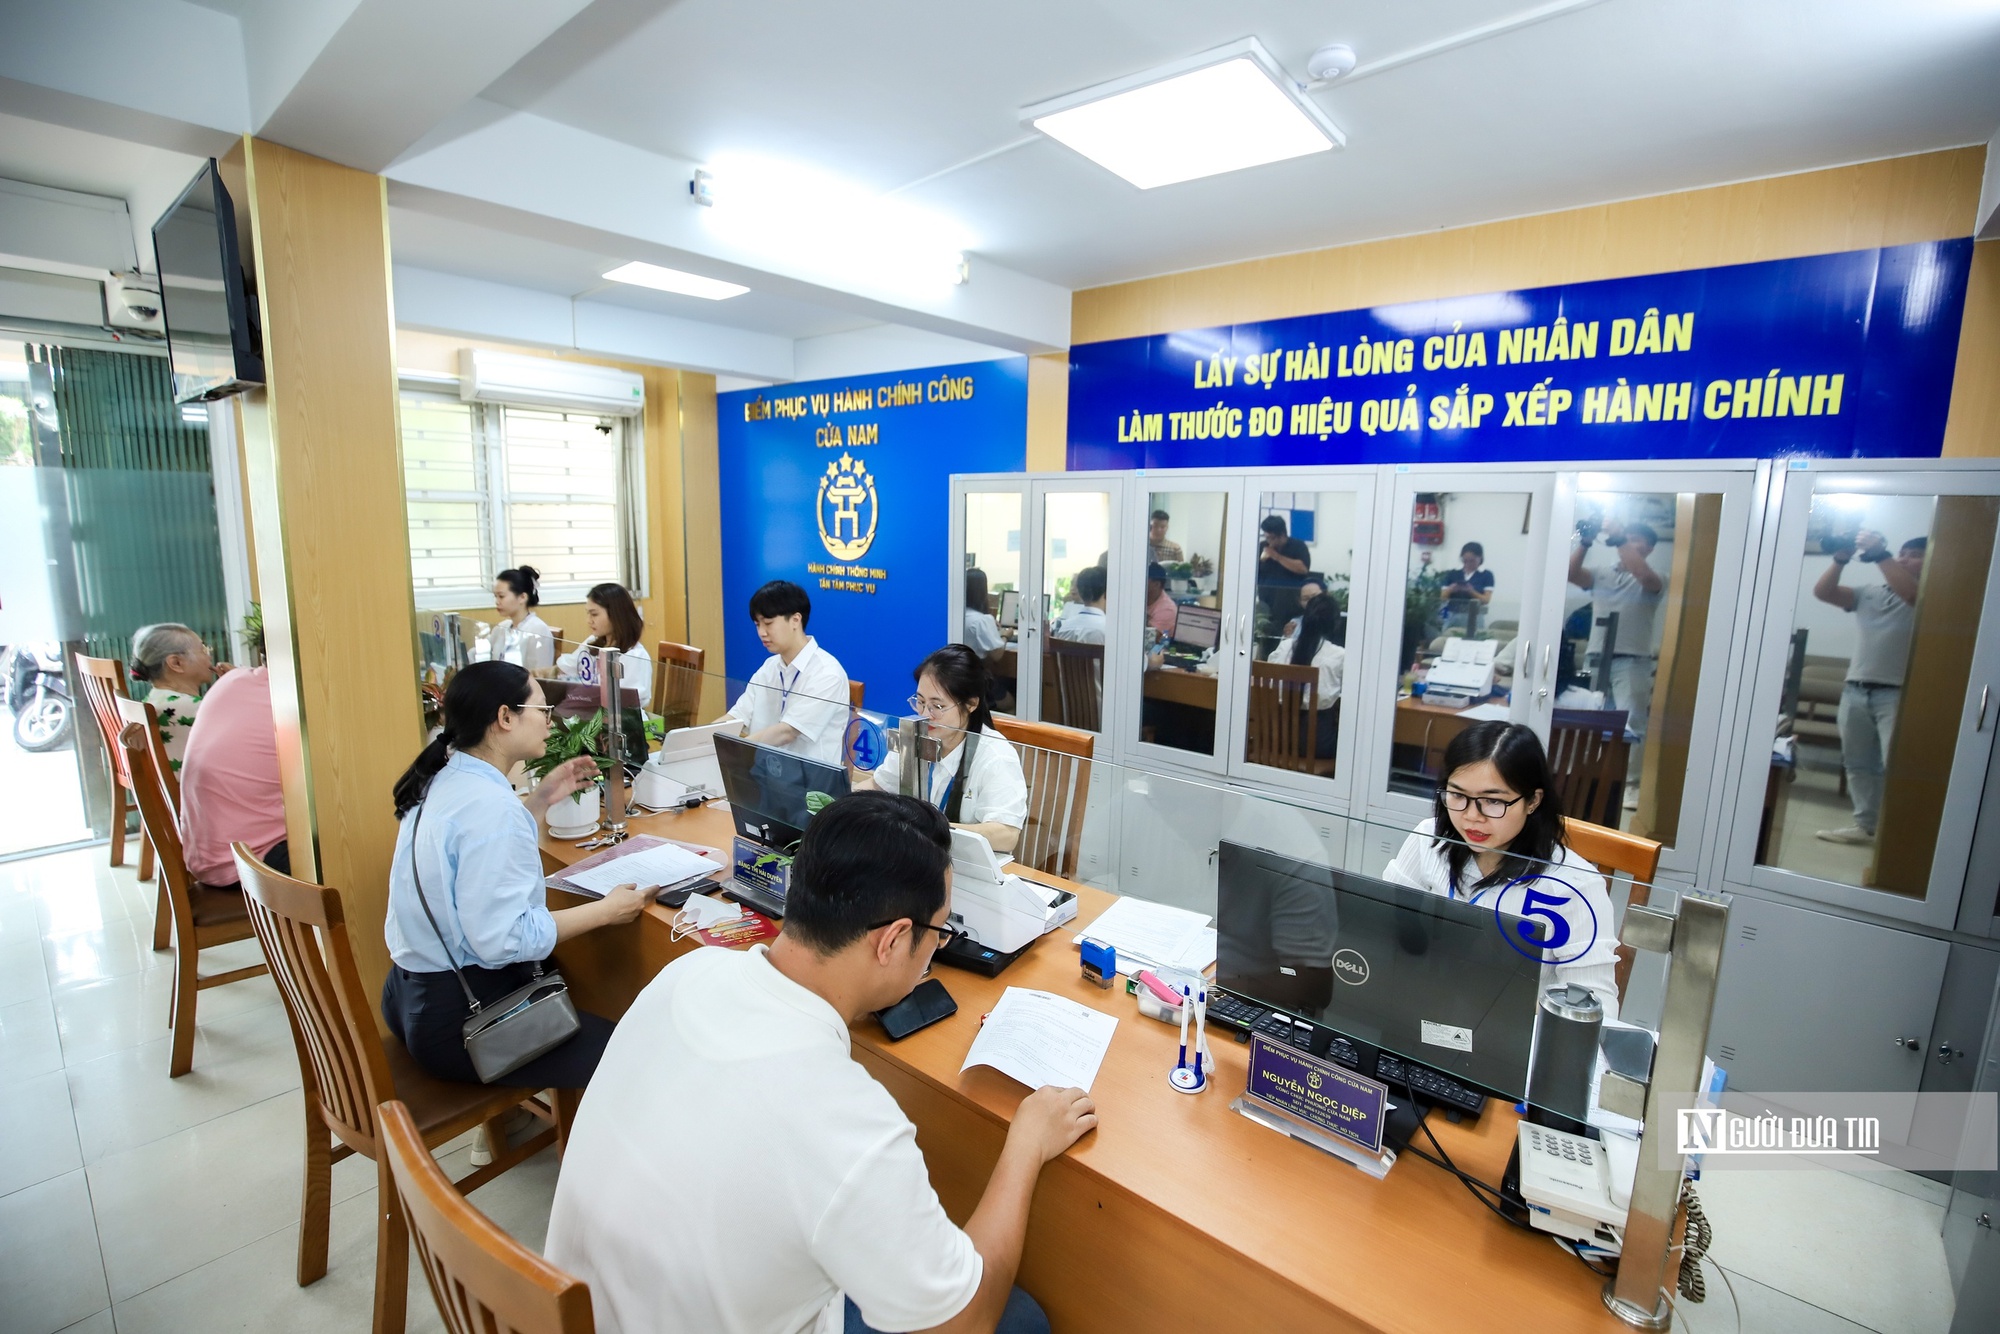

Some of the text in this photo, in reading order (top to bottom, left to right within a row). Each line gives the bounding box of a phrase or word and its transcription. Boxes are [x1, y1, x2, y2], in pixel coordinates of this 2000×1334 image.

[1194, 306, 1695, 390] LẤY SỰ HÀI LÒNG CỦA NHÂN DÂN
[774, 396, 807, 422] PHỤC
[810, 393, 830, 418] VỤ
[833, 386, 873, 413] HÀNH
[877, 380, 922, 408] CHÍNH
[927, 373, 974, 403] CÔNG
[1118, 368, 1846, 443] LÀM THƯỚC ĐO HIỆU QUẢ SẮP XẾP HÀNH CHÍNH
[816, 421, 878, 448] CỬA NAM
[807, 561, 887, 580] HÀNH CHÍNH THÔNG MINH
[819, 577, 876, 594] TẬN TÂM PHỤC VỤ
[581, 656, 591, 681] 3
[852, 729, 873, 763] 4
[1517, 887, 1572, 949] 5
[1336, 958, 1365, 976] DELL
[1262, 1070, 1367, 1120] NGUYỄN NGỌC DIỆP
[1314, 1064, 1330, 1076] CHÍNH
[1331, 1072, 1347, 1084] CÔNG
[1348, 1078, 1359, 1089] CỬA
[1360, 1086, 1373, 1094] NAM
